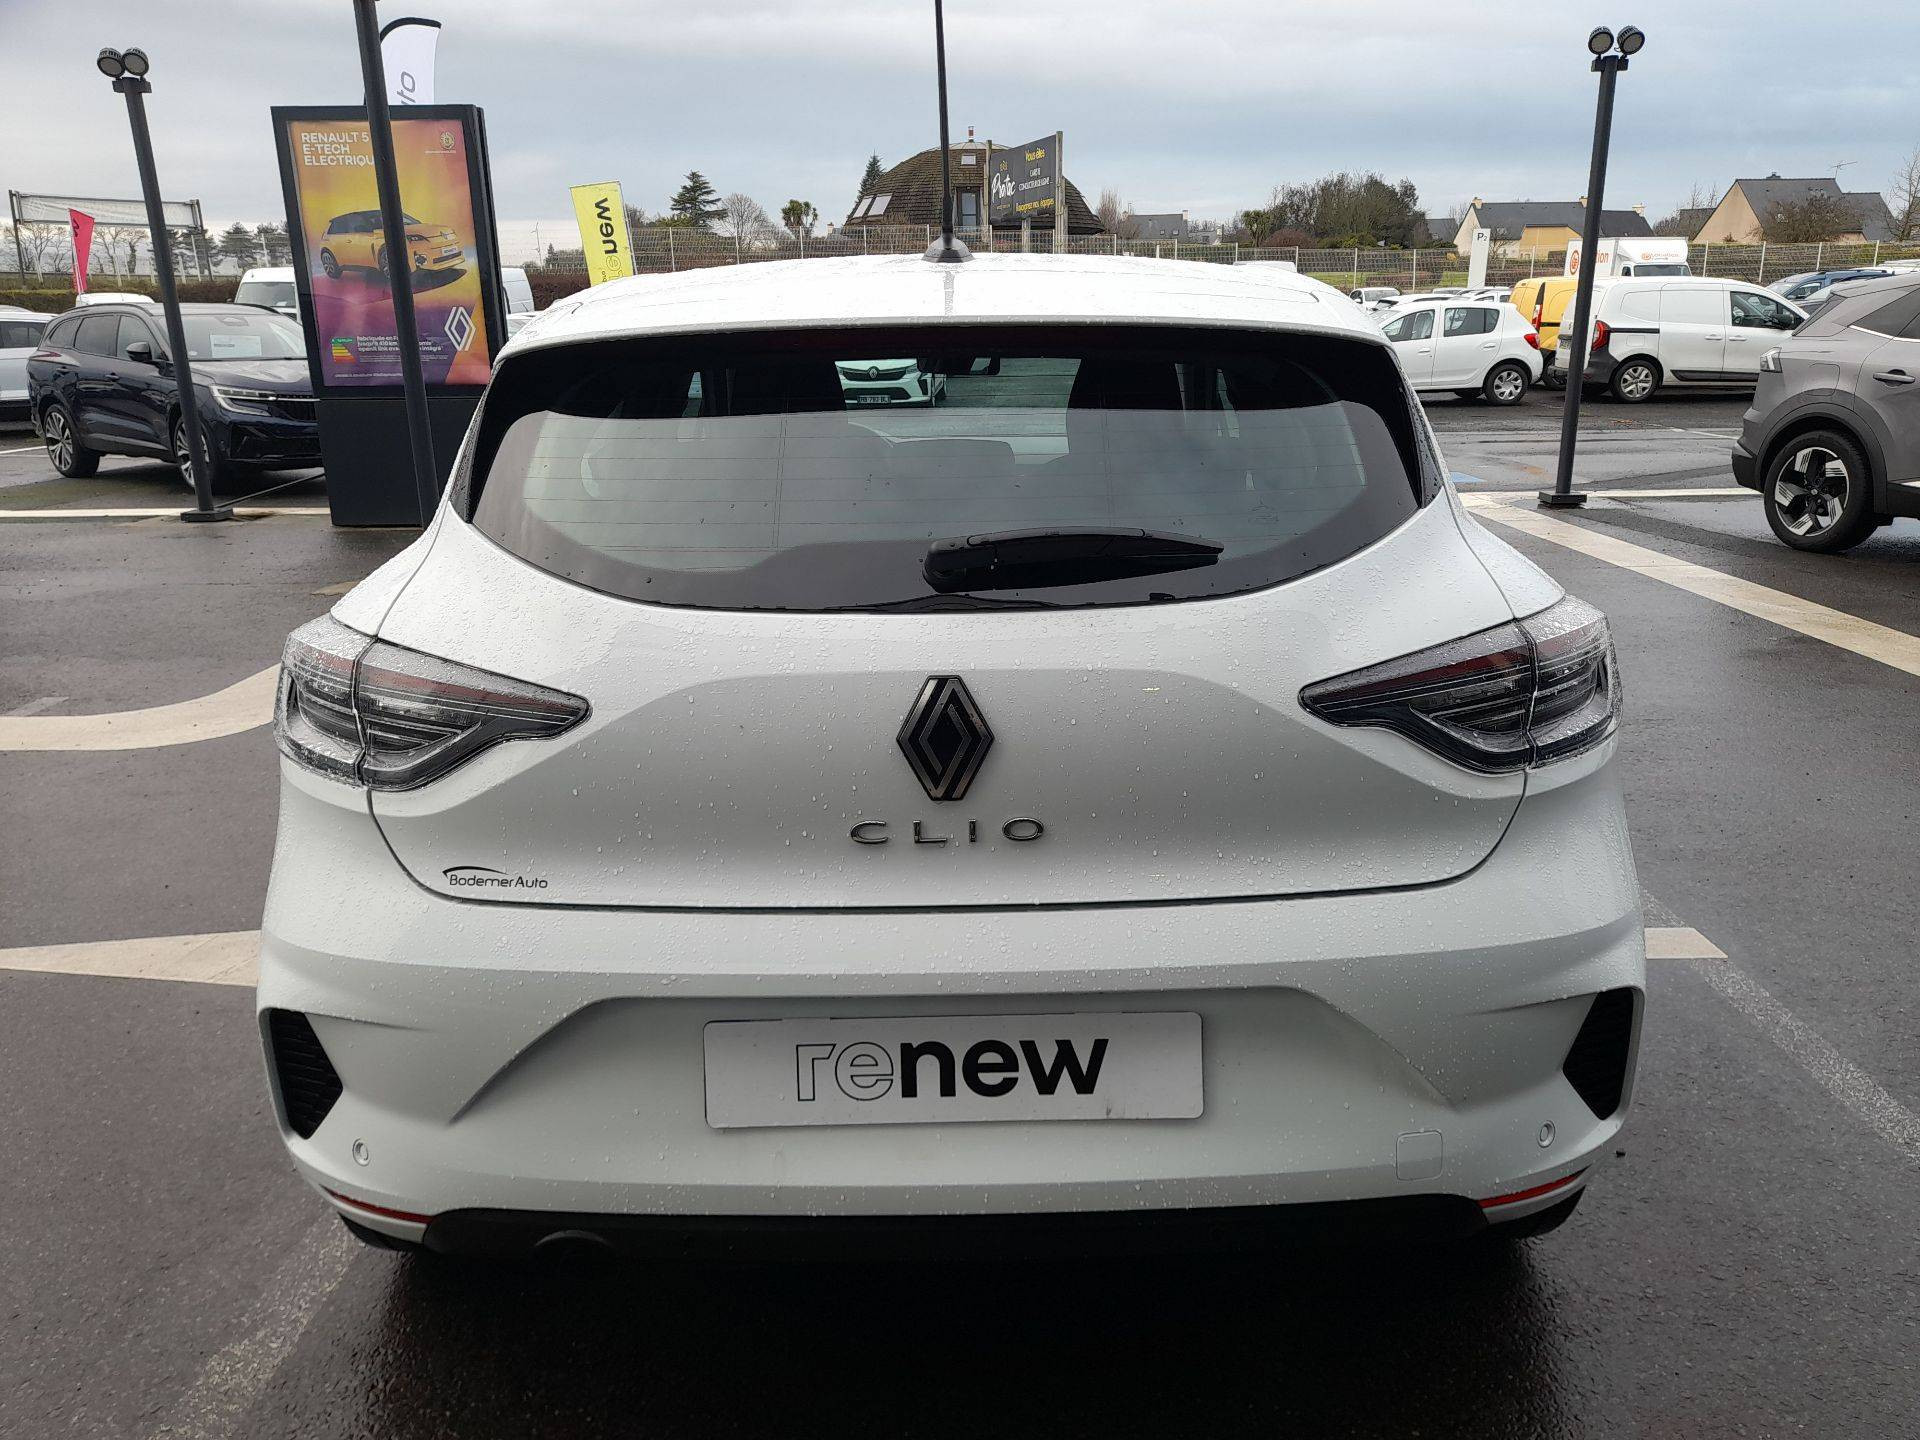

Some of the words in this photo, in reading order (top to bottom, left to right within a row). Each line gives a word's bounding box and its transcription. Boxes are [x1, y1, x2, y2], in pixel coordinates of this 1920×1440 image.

[301, 132, 358, 143] RENAULT
[361, 132, 369, 141] 5
[303, 143, 350, 154] E-TECH
[304, 155, 374, 167] ELECTRIQU
[850, 816, 1045, 845] CLIO
[449, 873, 548, 889] BodemerAuto
[795, 1037, 1110, 1101] renew
